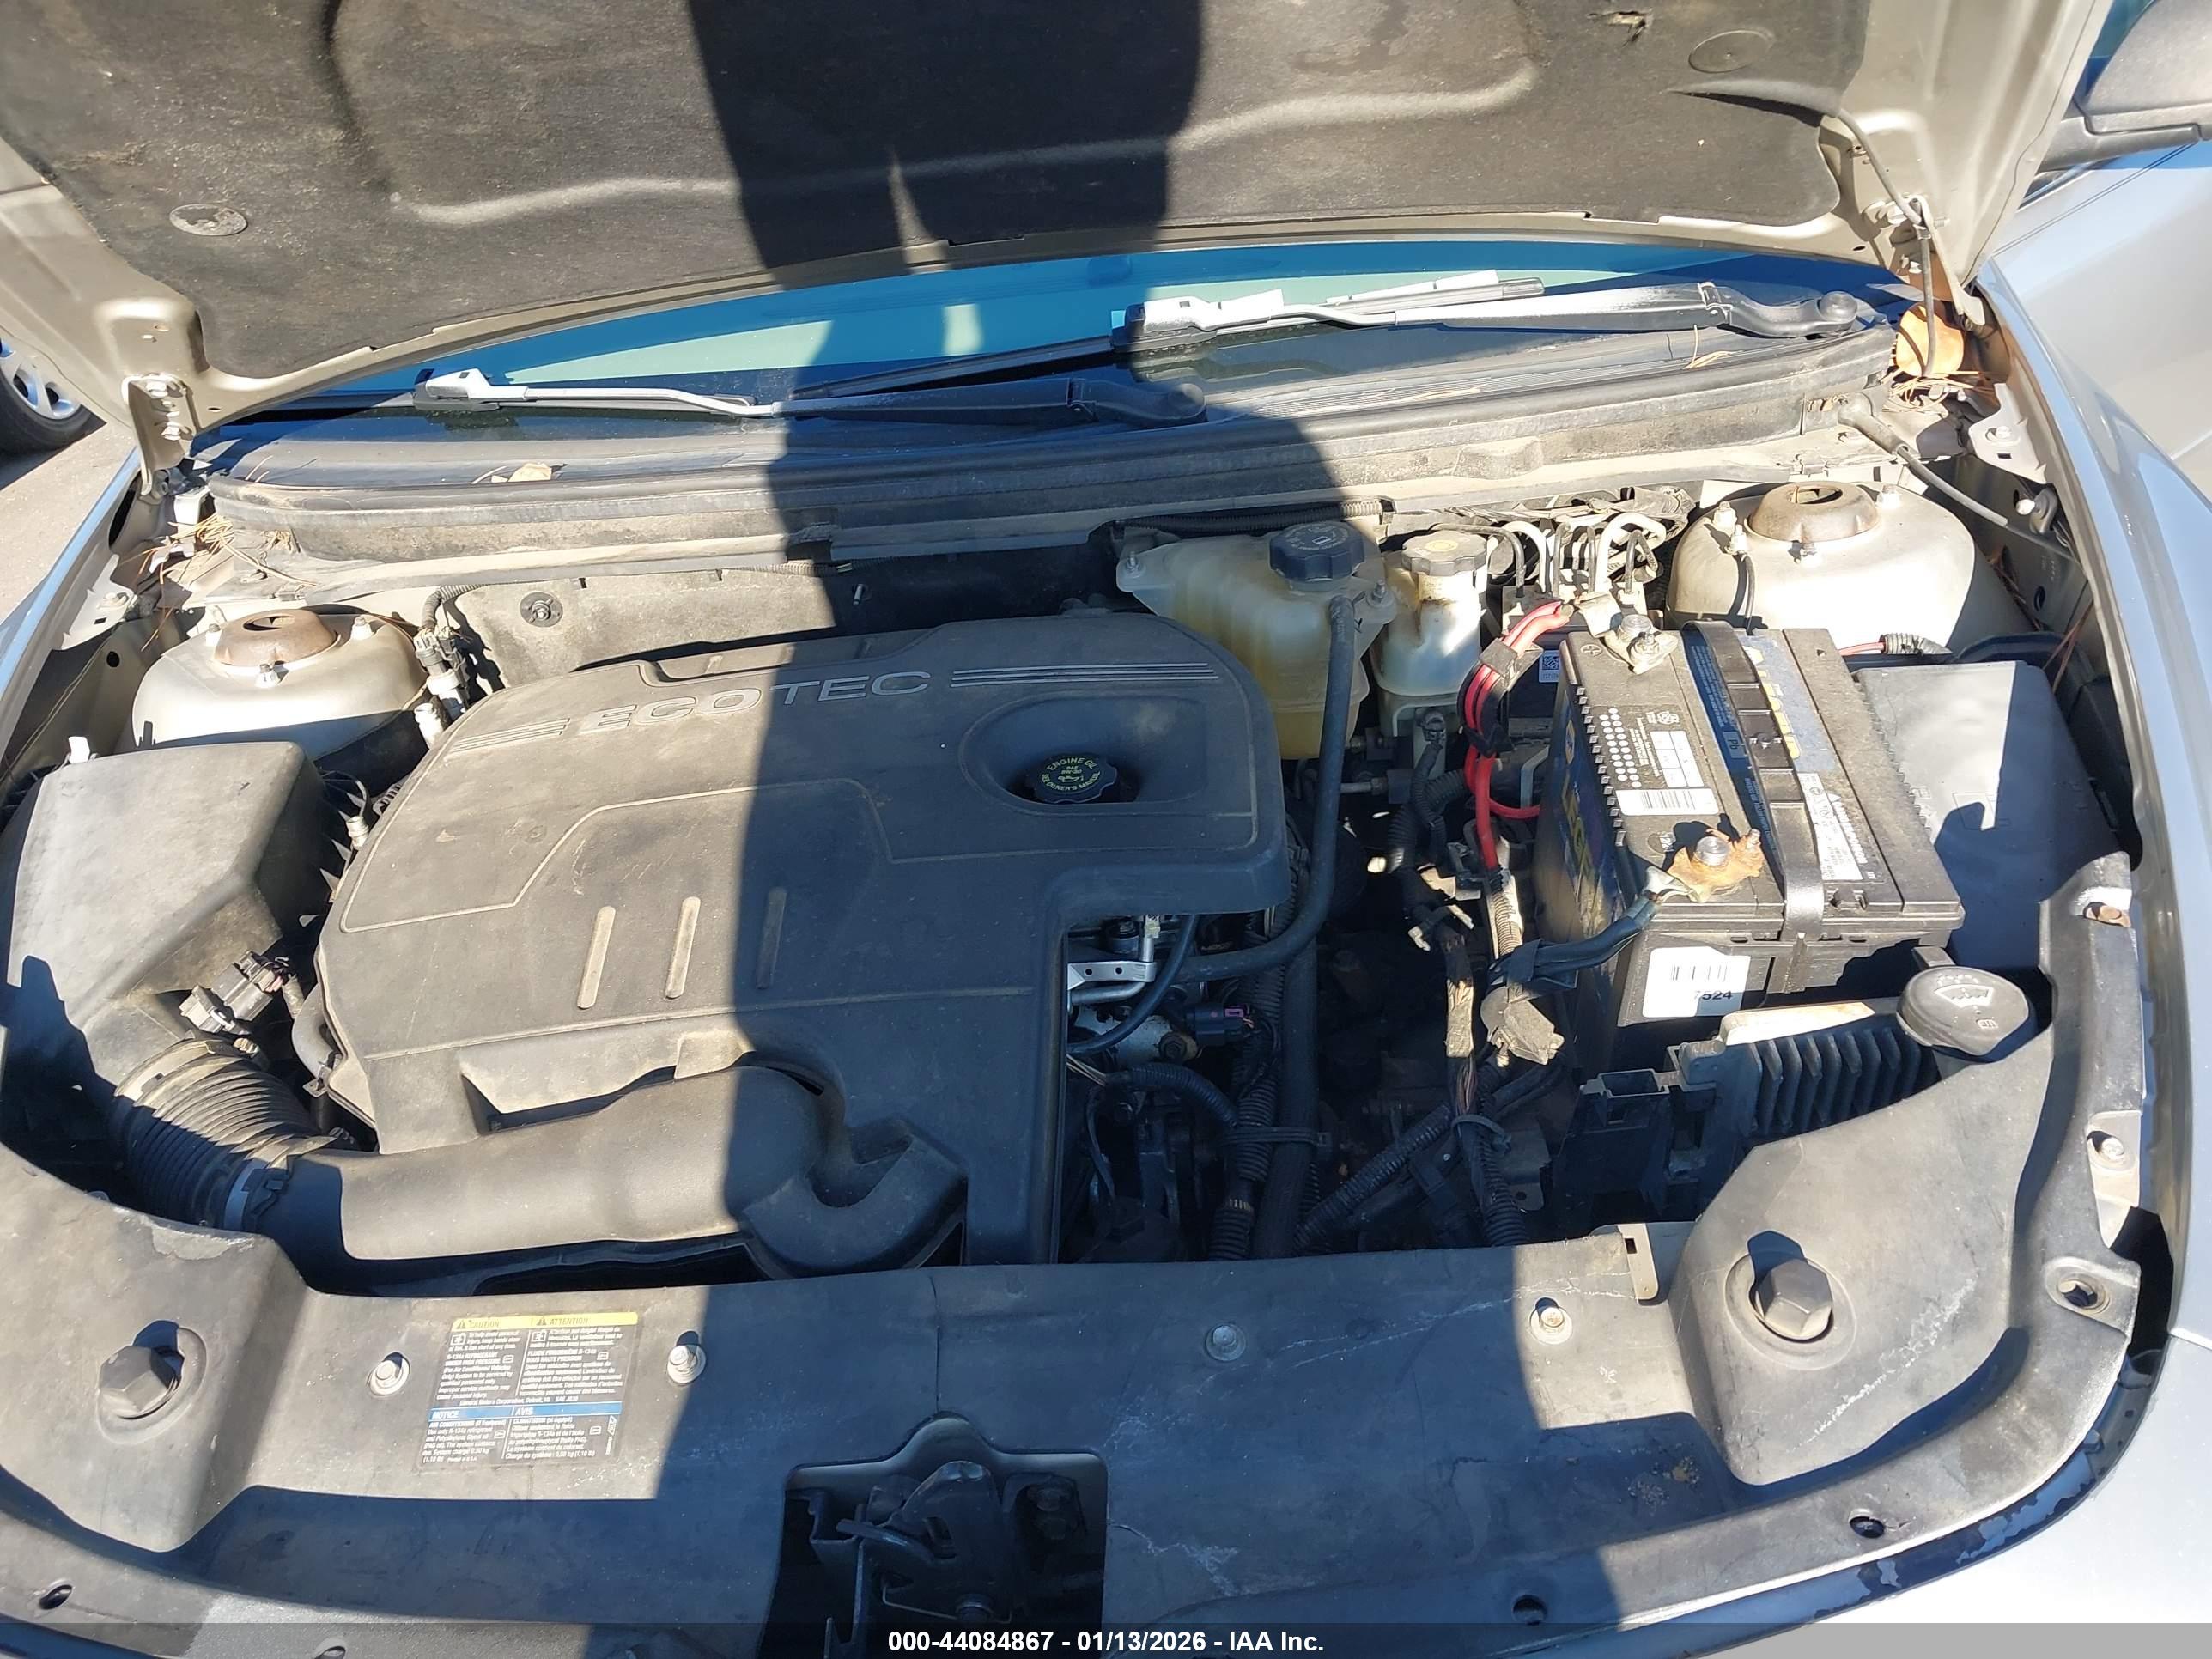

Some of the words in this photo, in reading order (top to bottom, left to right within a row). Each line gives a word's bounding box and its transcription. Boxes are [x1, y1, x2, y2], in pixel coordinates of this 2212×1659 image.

[583, 671, 932, 734] ECOTEC
[1729, 738, 1740, 750] Pb
[1047, 757, 1085, 771] ENGINE
[1085, 759, 1098, 770] OIL
[1042, 774, 1050, 783] SEE
[1694, 990, 1733, 1000] 7524
[515, 1407, 534, 1416] AVIS
